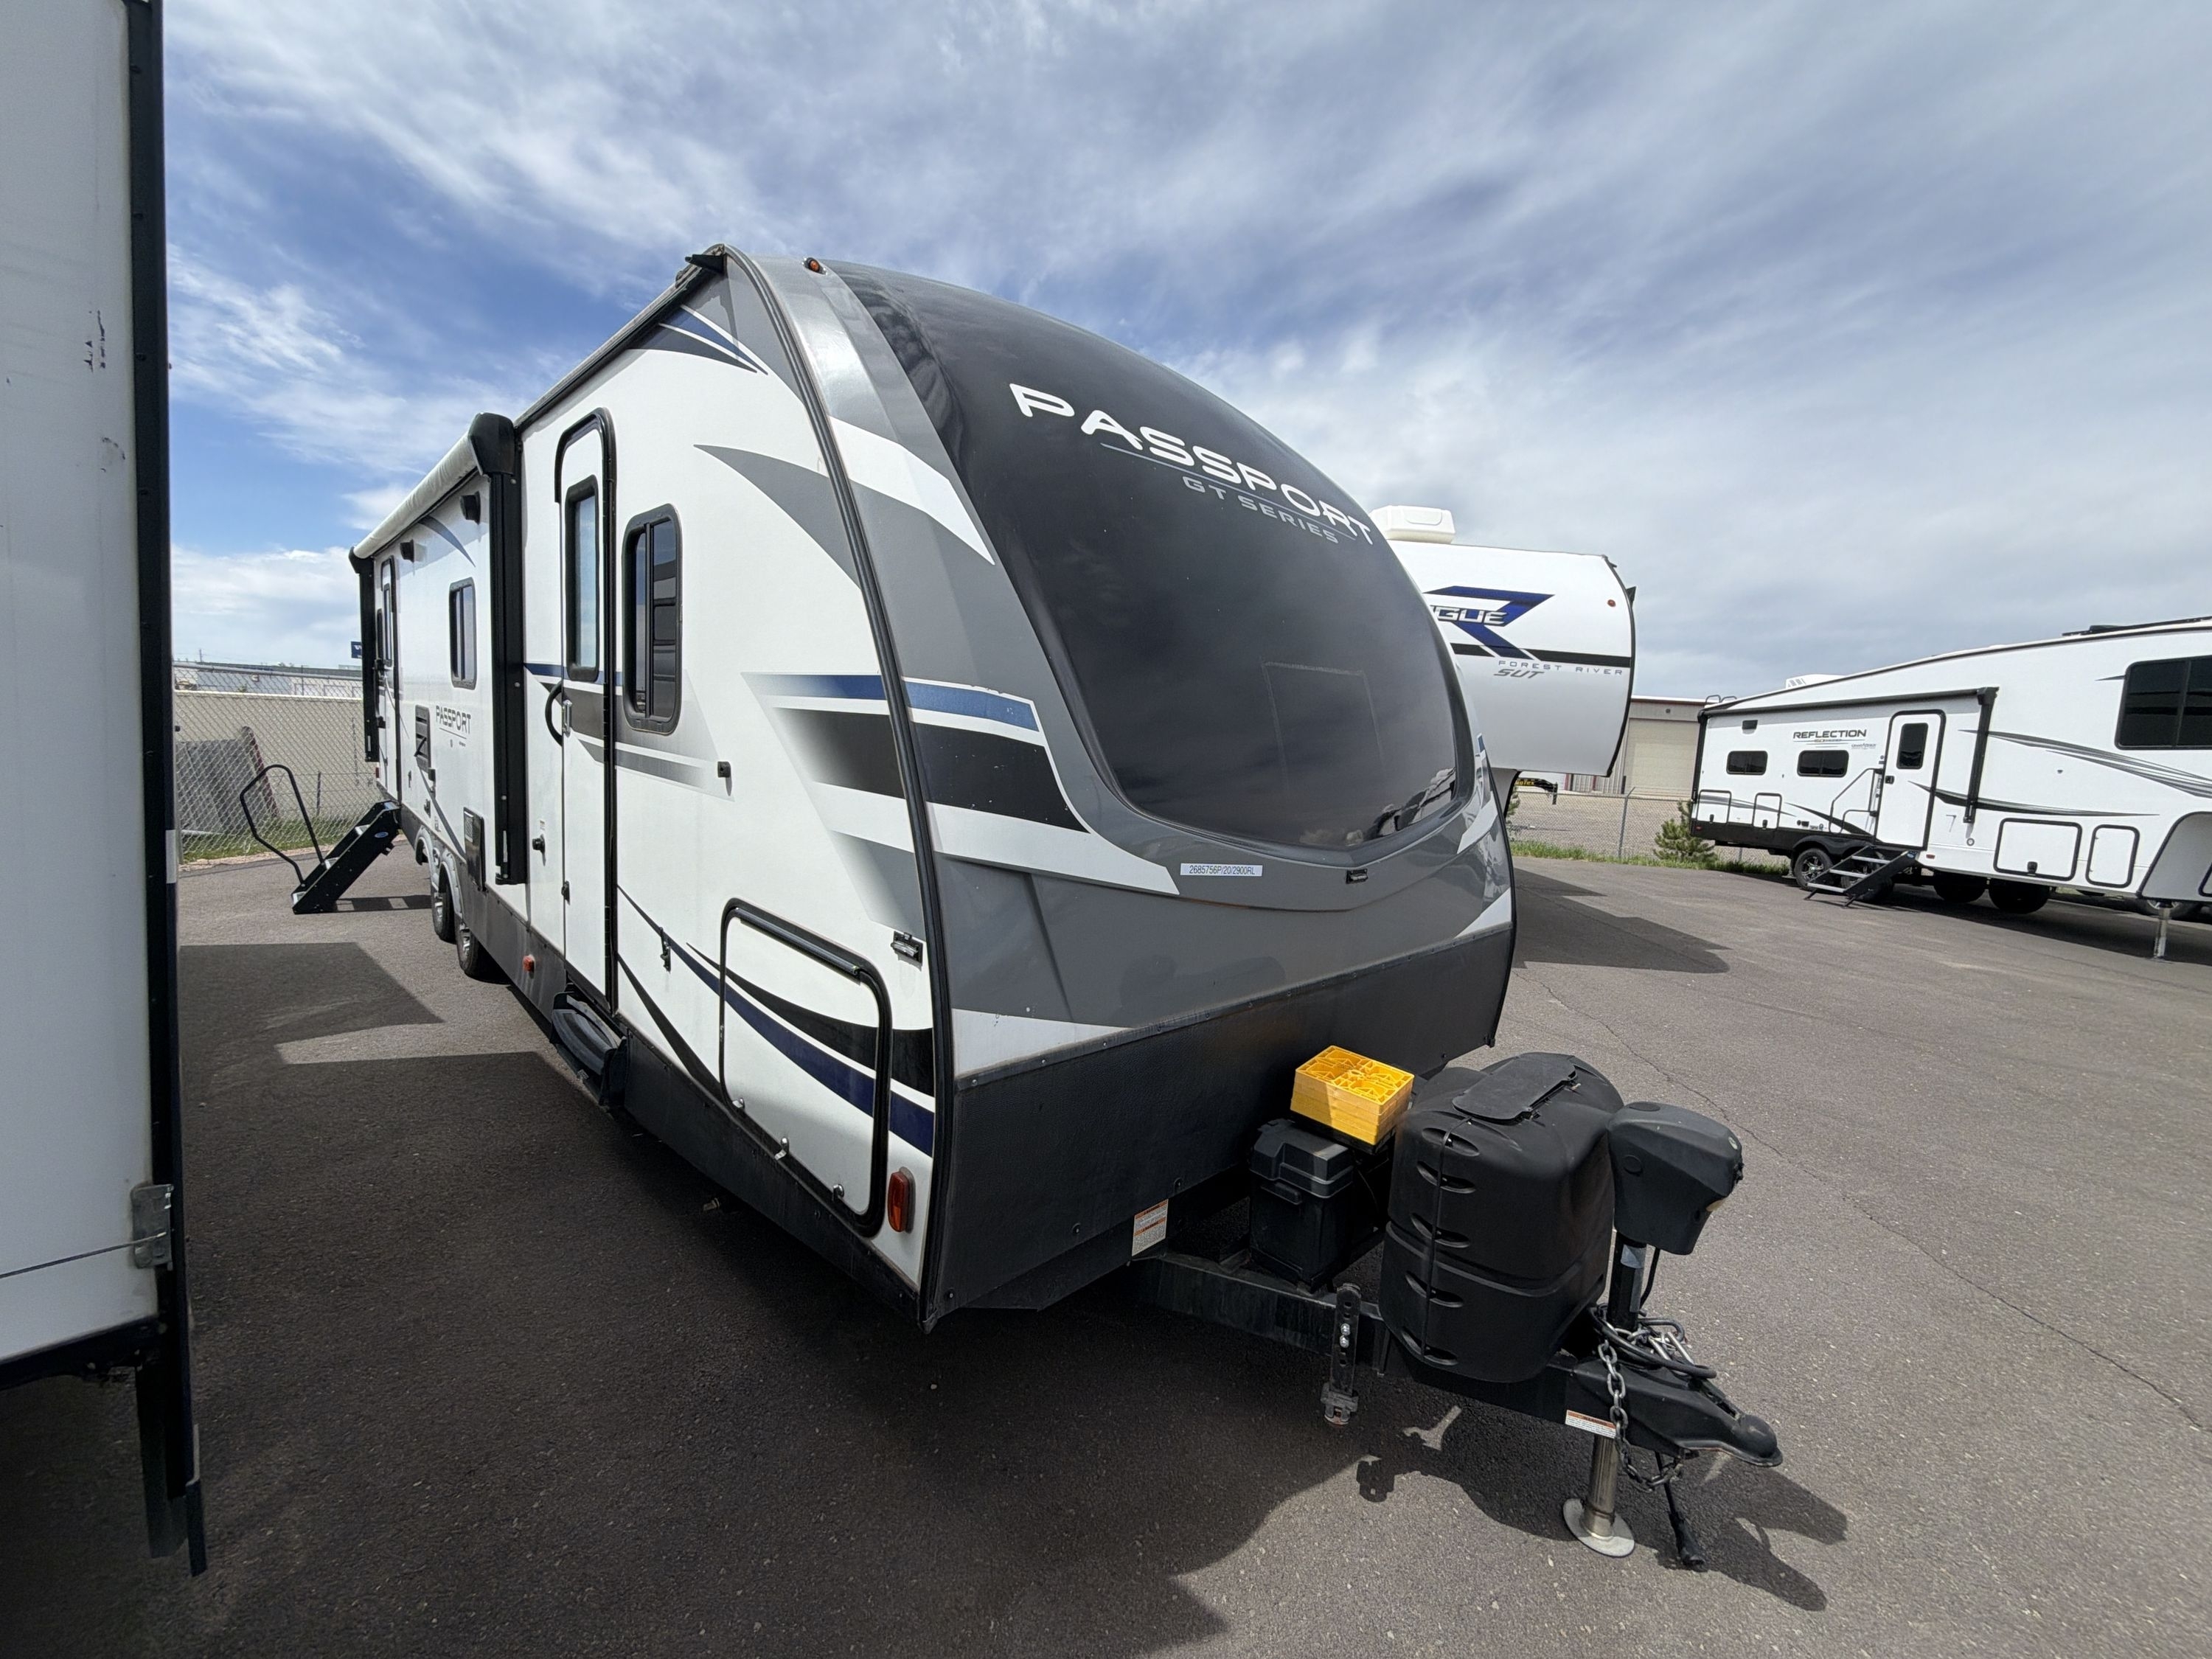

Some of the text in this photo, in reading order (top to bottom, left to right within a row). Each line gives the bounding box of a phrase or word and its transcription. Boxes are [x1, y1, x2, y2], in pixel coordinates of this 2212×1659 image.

[1009, 383, 1374, 546] PASSPORT
[1183, 476, 1339, 544] GT SERIES
[1430, 605, 1508, 626] GUE
[1493, 668, 1545, 679] SUT
[1498, 660, 1623, 675] FOREST RIVER
[436, 705, 471, 734] PASSPORT
[1792, 729, 1867, 739] REFLECTION
